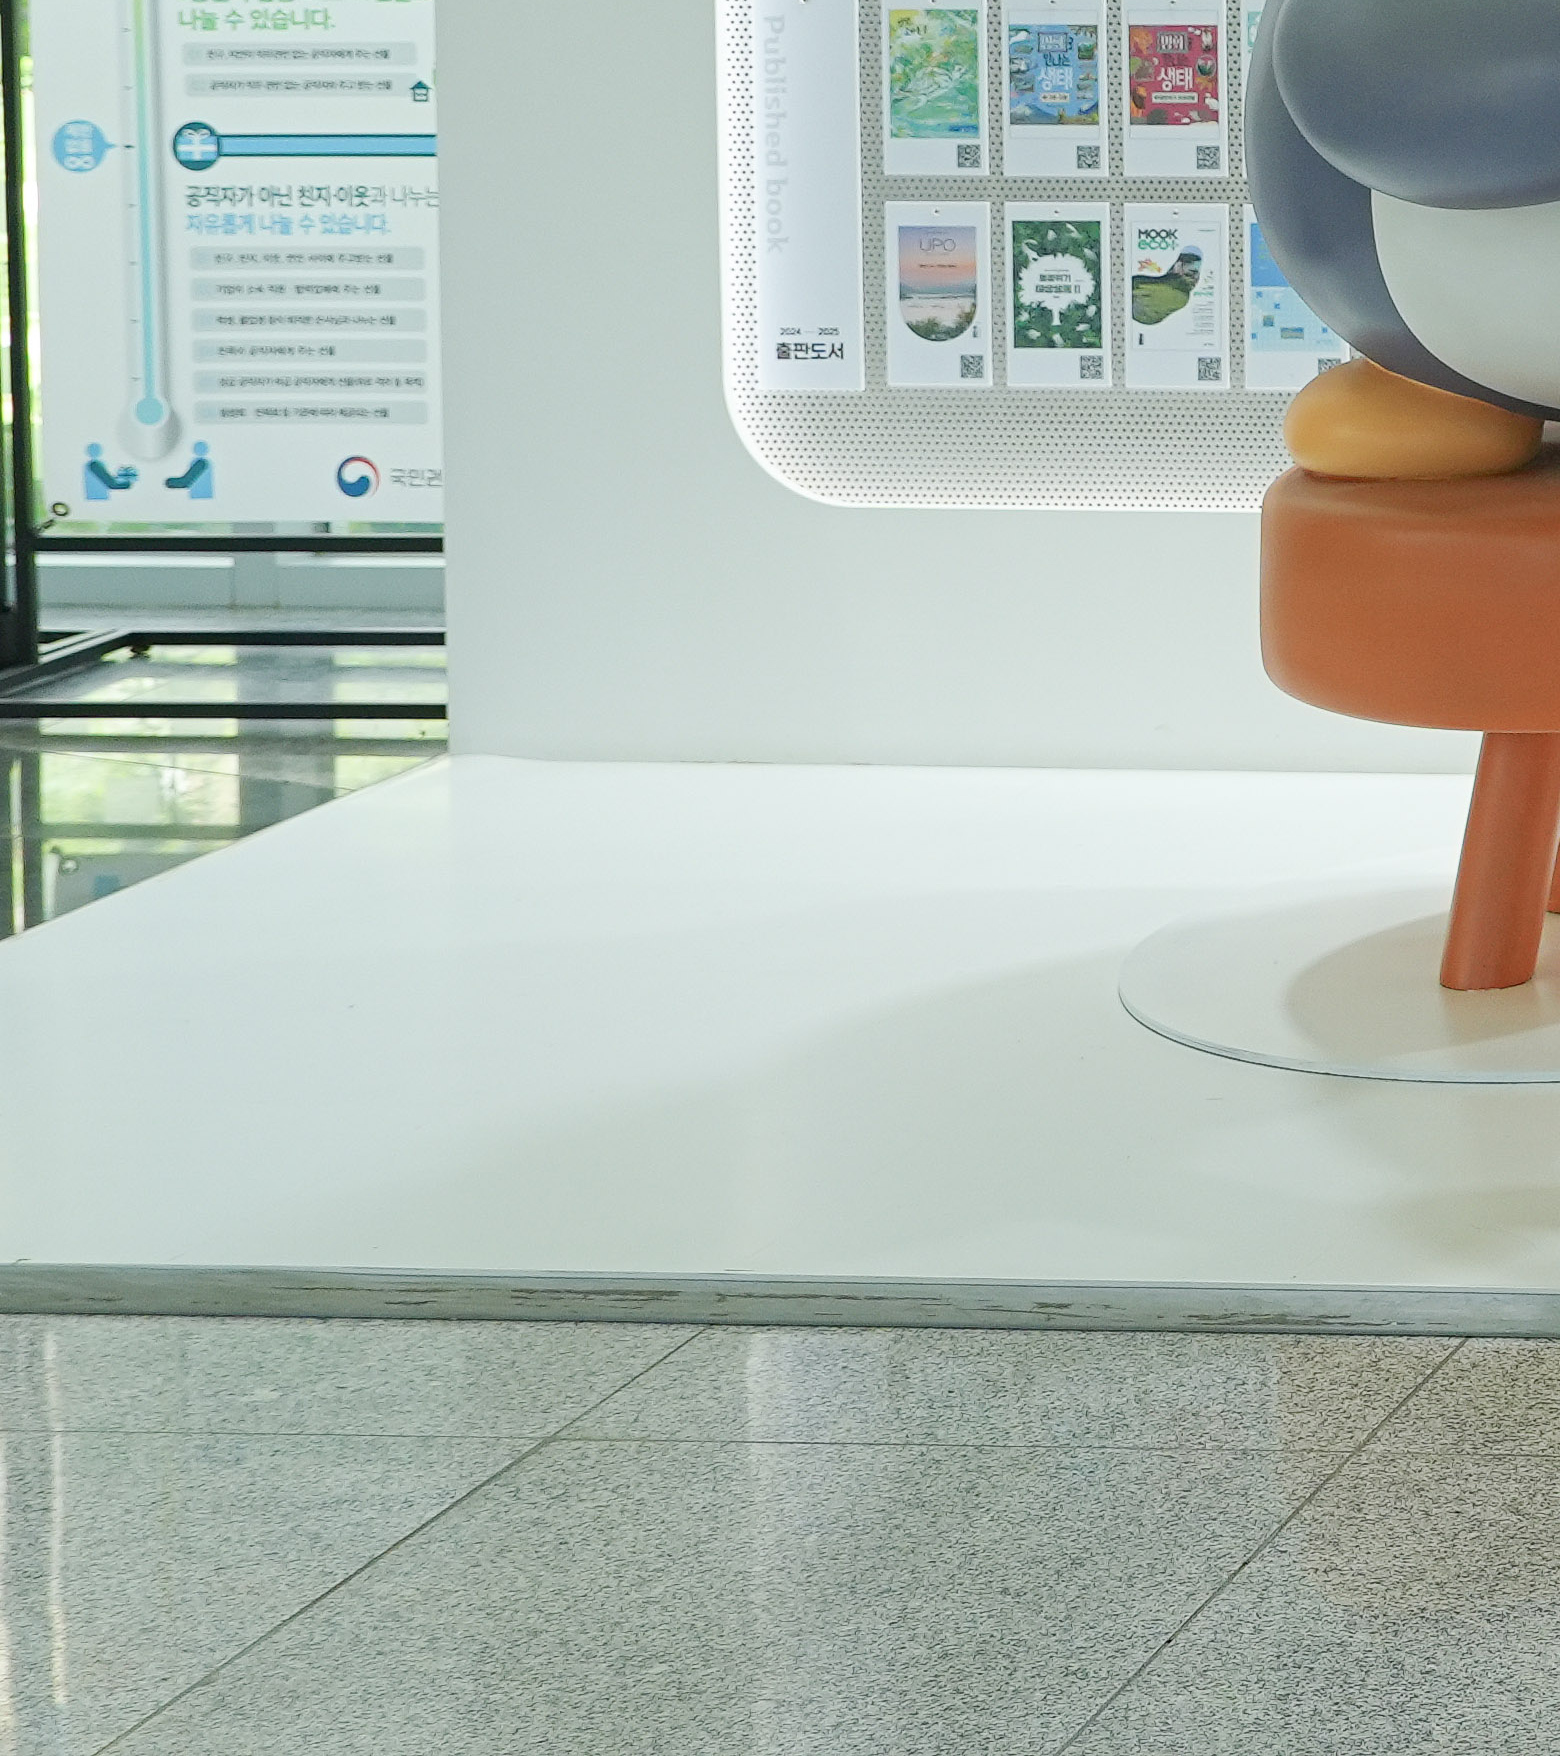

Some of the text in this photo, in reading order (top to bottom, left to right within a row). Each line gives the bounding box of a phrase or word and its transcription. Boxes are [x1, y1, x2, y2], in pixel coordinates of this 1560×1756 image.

[178, 8, 336, 30] 나눌 수 있습니다.
[1156, 66, 1194, 92] 생태
[764, 14, 789, 253] Published book
[186, 184, 254, 208] 공직자가
[1138, 229, 1178, 239] MOOK
[920, 238, 957, 252] UPO
[780, 327, 840, 336] 2024 2025
[776, 341, 845, 361] 출판도서
